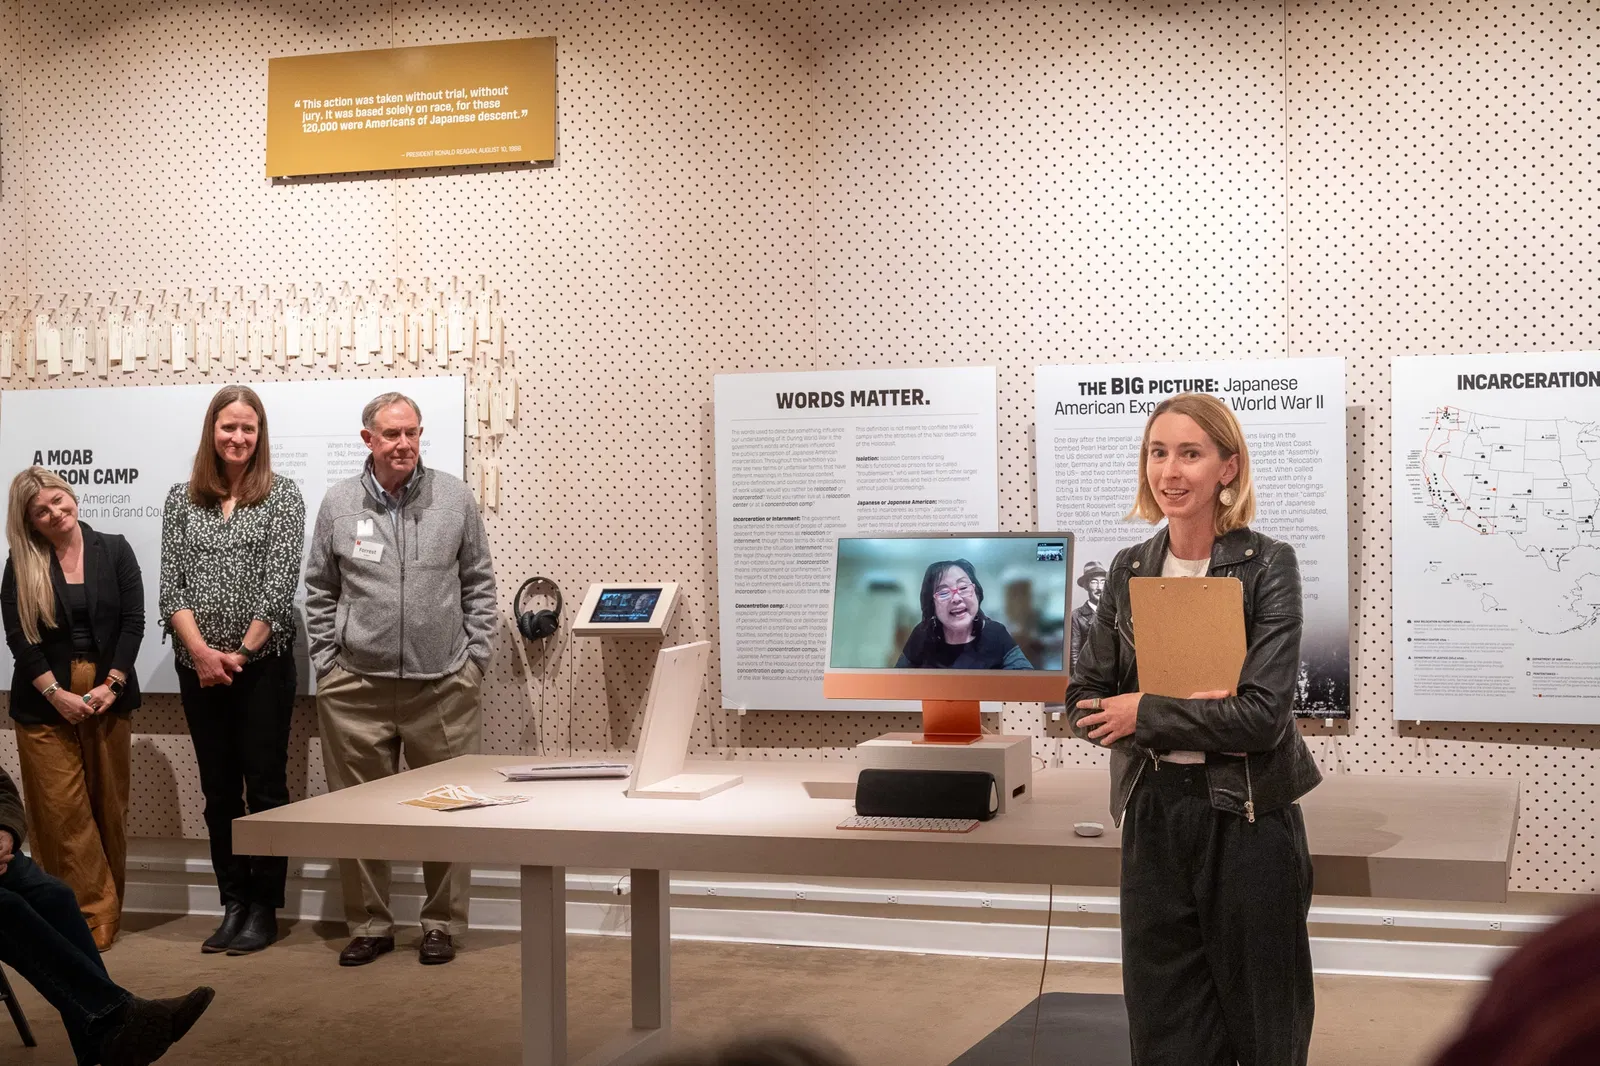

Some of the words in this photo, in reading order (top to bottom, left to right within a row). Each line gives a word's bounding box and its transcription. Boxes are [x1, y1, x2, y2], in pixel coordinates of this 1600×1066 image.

[324, 95, 353, 107] action
[355, 96, 374, 105] was
[376, 91, 403, 104] taken
[405, 89, 443, 102] without
[445, 87, 468, 102] trial,
[470, 85, 508, 98] without
[302, 112, 324, 123] jury.
[326, 108, 331, 120] It
[334, 110, 353, 119] was
[356, 105, 384, 118] based
[386, 103, 413, 118] solely
[416, 105, 428, 114] on
[430, 103, 454, 114] race,
[456, 100, 470, 111] for
[473, 98, 500, 110] these
[302, 120, 338, 134] 120,000
[340, 121, 363, 130] were
[365, 115, 415, 129] Americans
[418, 114, 428, 126] of
[430, 111, 476, 128] Japanese
[478, 108, 528, 122] descent.”
[1078, 382, 1107, 395] THE
[1111, 377, 1144, 394] BIG
[1149, 379, 1218, 394] PICTURE:
[1224, 377, 1298, 395] Japanese
[776, 390, 844, 409] WORDS
[851, 387, 930, 407] MATTER.
[1055, 400, 1125, 415] American
[1232, 395, 1276, 411] World
[1281, 394, 1312, 410] War
[1316, 394, 1324, 409] II
[33, 450, 43, 465] A
[48, 449, 92, 465] MOAB
[94, 468, 138, 484] CAMP
[82, 493, 130, 504] American
[101, 507, 110, 517] in
[113, 506, 143, 517] Grand
